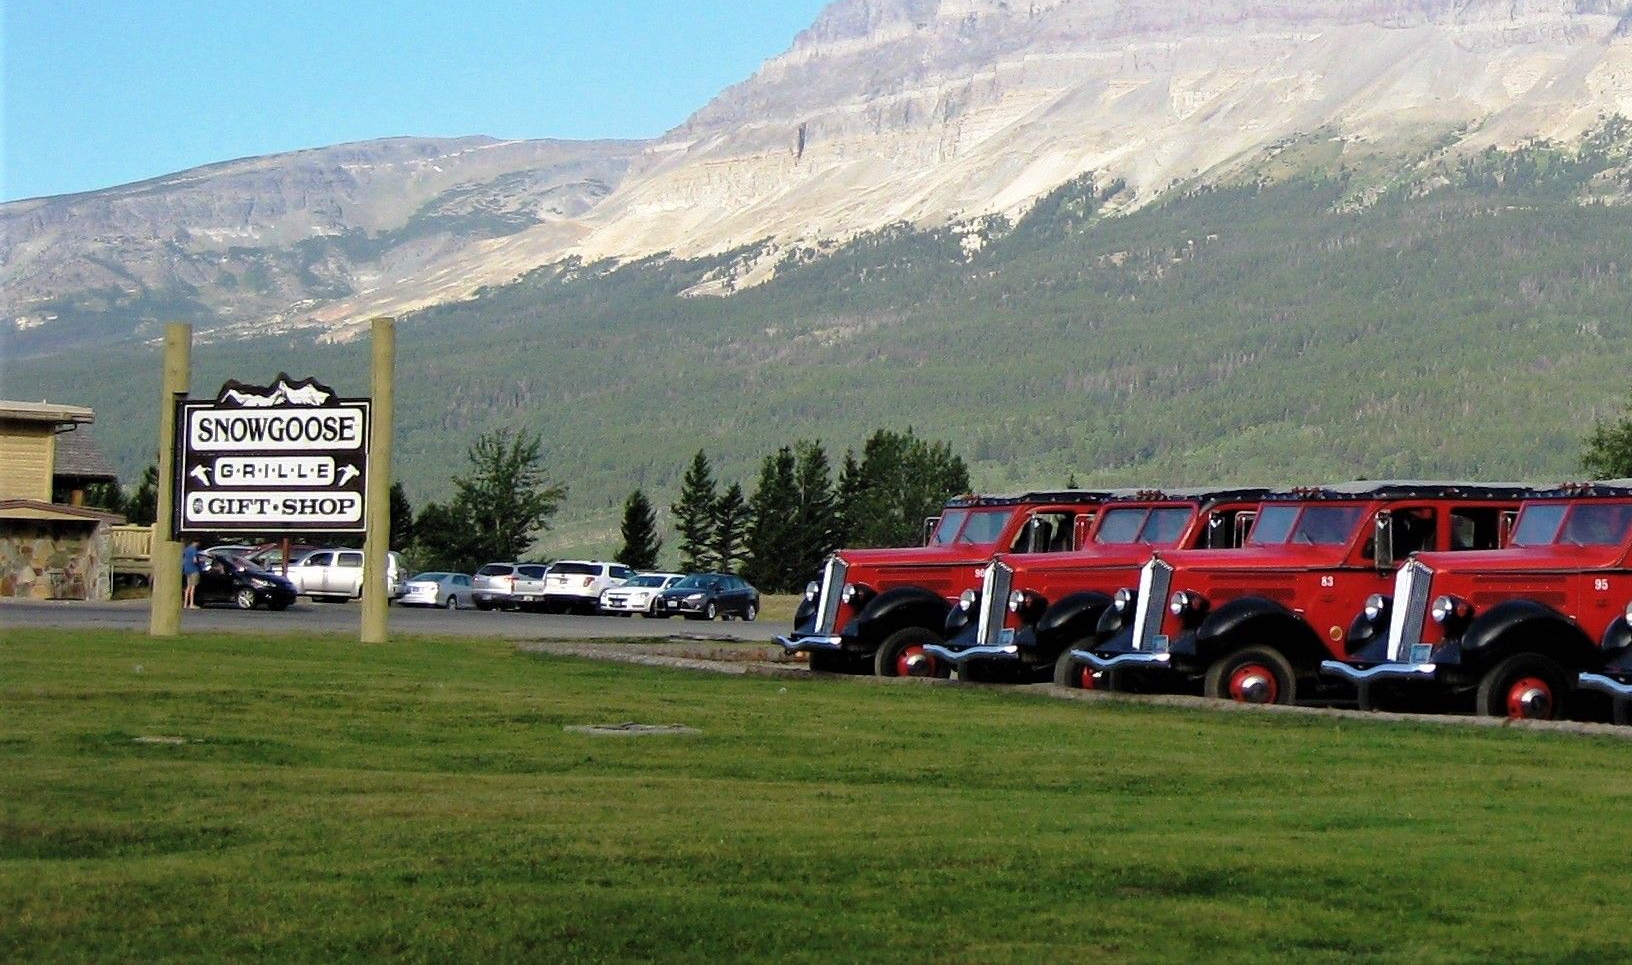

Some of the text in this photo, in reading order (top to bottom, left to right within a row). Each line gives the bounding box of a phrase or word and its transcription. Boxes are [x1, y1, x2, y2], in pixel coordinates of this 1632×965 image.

[199, 417, 355, 442] SNOWGOOSE
[1321, 576, 1333, 586] 83
[1594, 579, 1608, 590] 95
